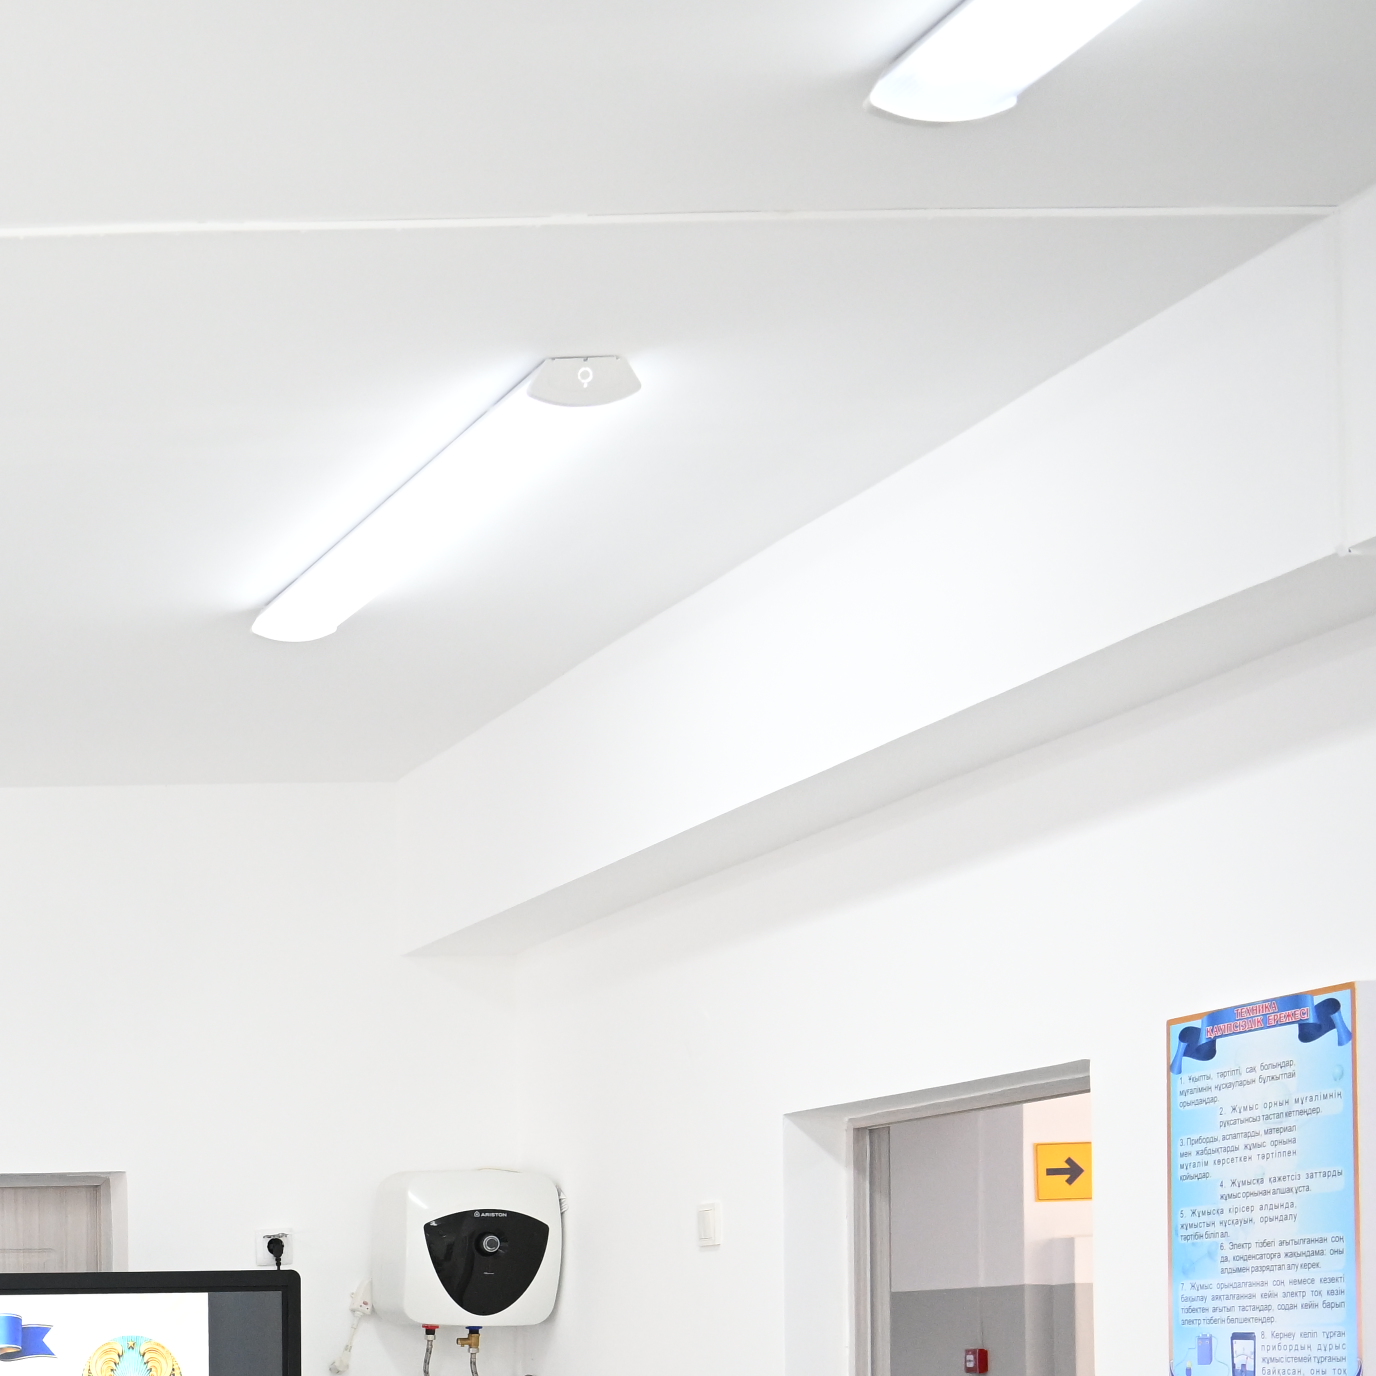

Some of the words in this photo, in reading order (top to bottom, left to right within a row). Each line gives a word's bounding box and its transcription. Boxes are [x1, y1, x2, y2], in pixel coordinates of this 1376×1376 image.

[1234, 1001, 1279, 1019] ТЕХНИКА
[1267, 1007, 1310, 1027] ЕРЕЖЕСІ
[1219, 1106, 1226, 1116] 2.
[1230, 1103, 1259, 1114] Жұмыс
[1179, 1138, 1186, 1147] 3.
[1263, 1124, 1297, 1136] материал
[1179, 1150, 1192, 1158] мен
[1243, 1140, 1267, 1151] жұмыс
[1270, 1137, 1297, 1148] орнына
[1179, 1159, 1209, 1171] мұғалім
[1219, 1180, 1226, 1189] 4.
[1305, 1168, 1344, 1181] заттарды
[1180, 1210, 1187, 1219] 5.
[1228, 1203, 1255, 1215] кірісер
[1219, 1242, 1226, 1251] 6.
[1289, 1277, 1315, 1286] немесе
[1260, 1330, 1267, 1340] 8.
[1270, 1330, 1296, 1341] Кернеу
[1322, 1330, 1346, 1339] тұрған
[1260, 1342, 1312, 1353] прибордың
[1317, 1342, 1347, 1353] дұрыс
[1310, 1368, 1327, 1376] оны
